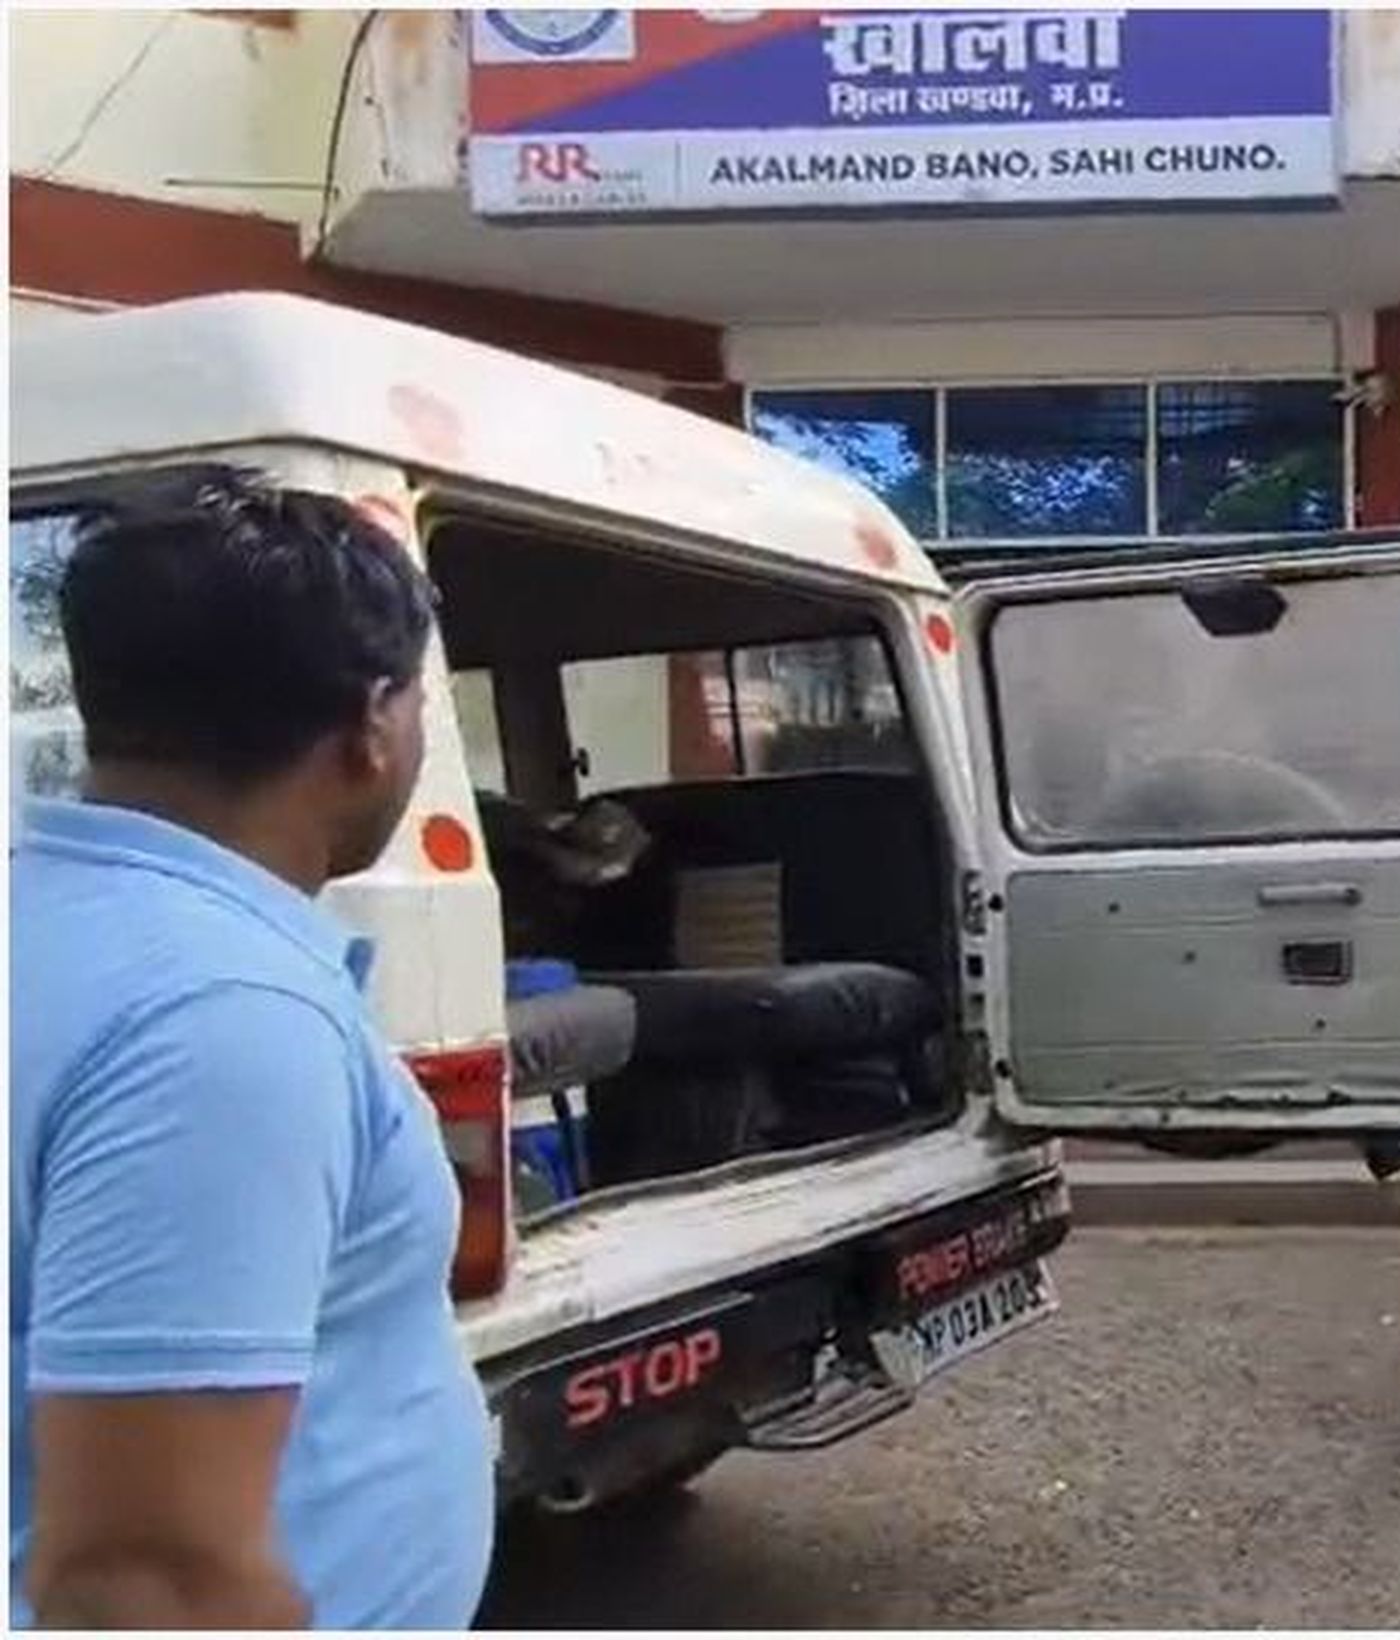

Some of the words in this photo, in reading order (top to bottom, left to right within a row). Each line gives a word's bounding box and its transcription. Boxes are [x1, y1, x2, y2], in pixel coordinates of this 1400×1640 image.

[820, 10, 1126, 74] खालवा
[516, 143, 600, 182] RR
[710, 154, 915, 184] AKALMAND
[925, 150, 1038, 179] BANO,
[1049, 148, 1134, 175] SAHI
[1144, 143, 1286, 172] CHUNO.
[563, 1327, 721, 1428] STOP
